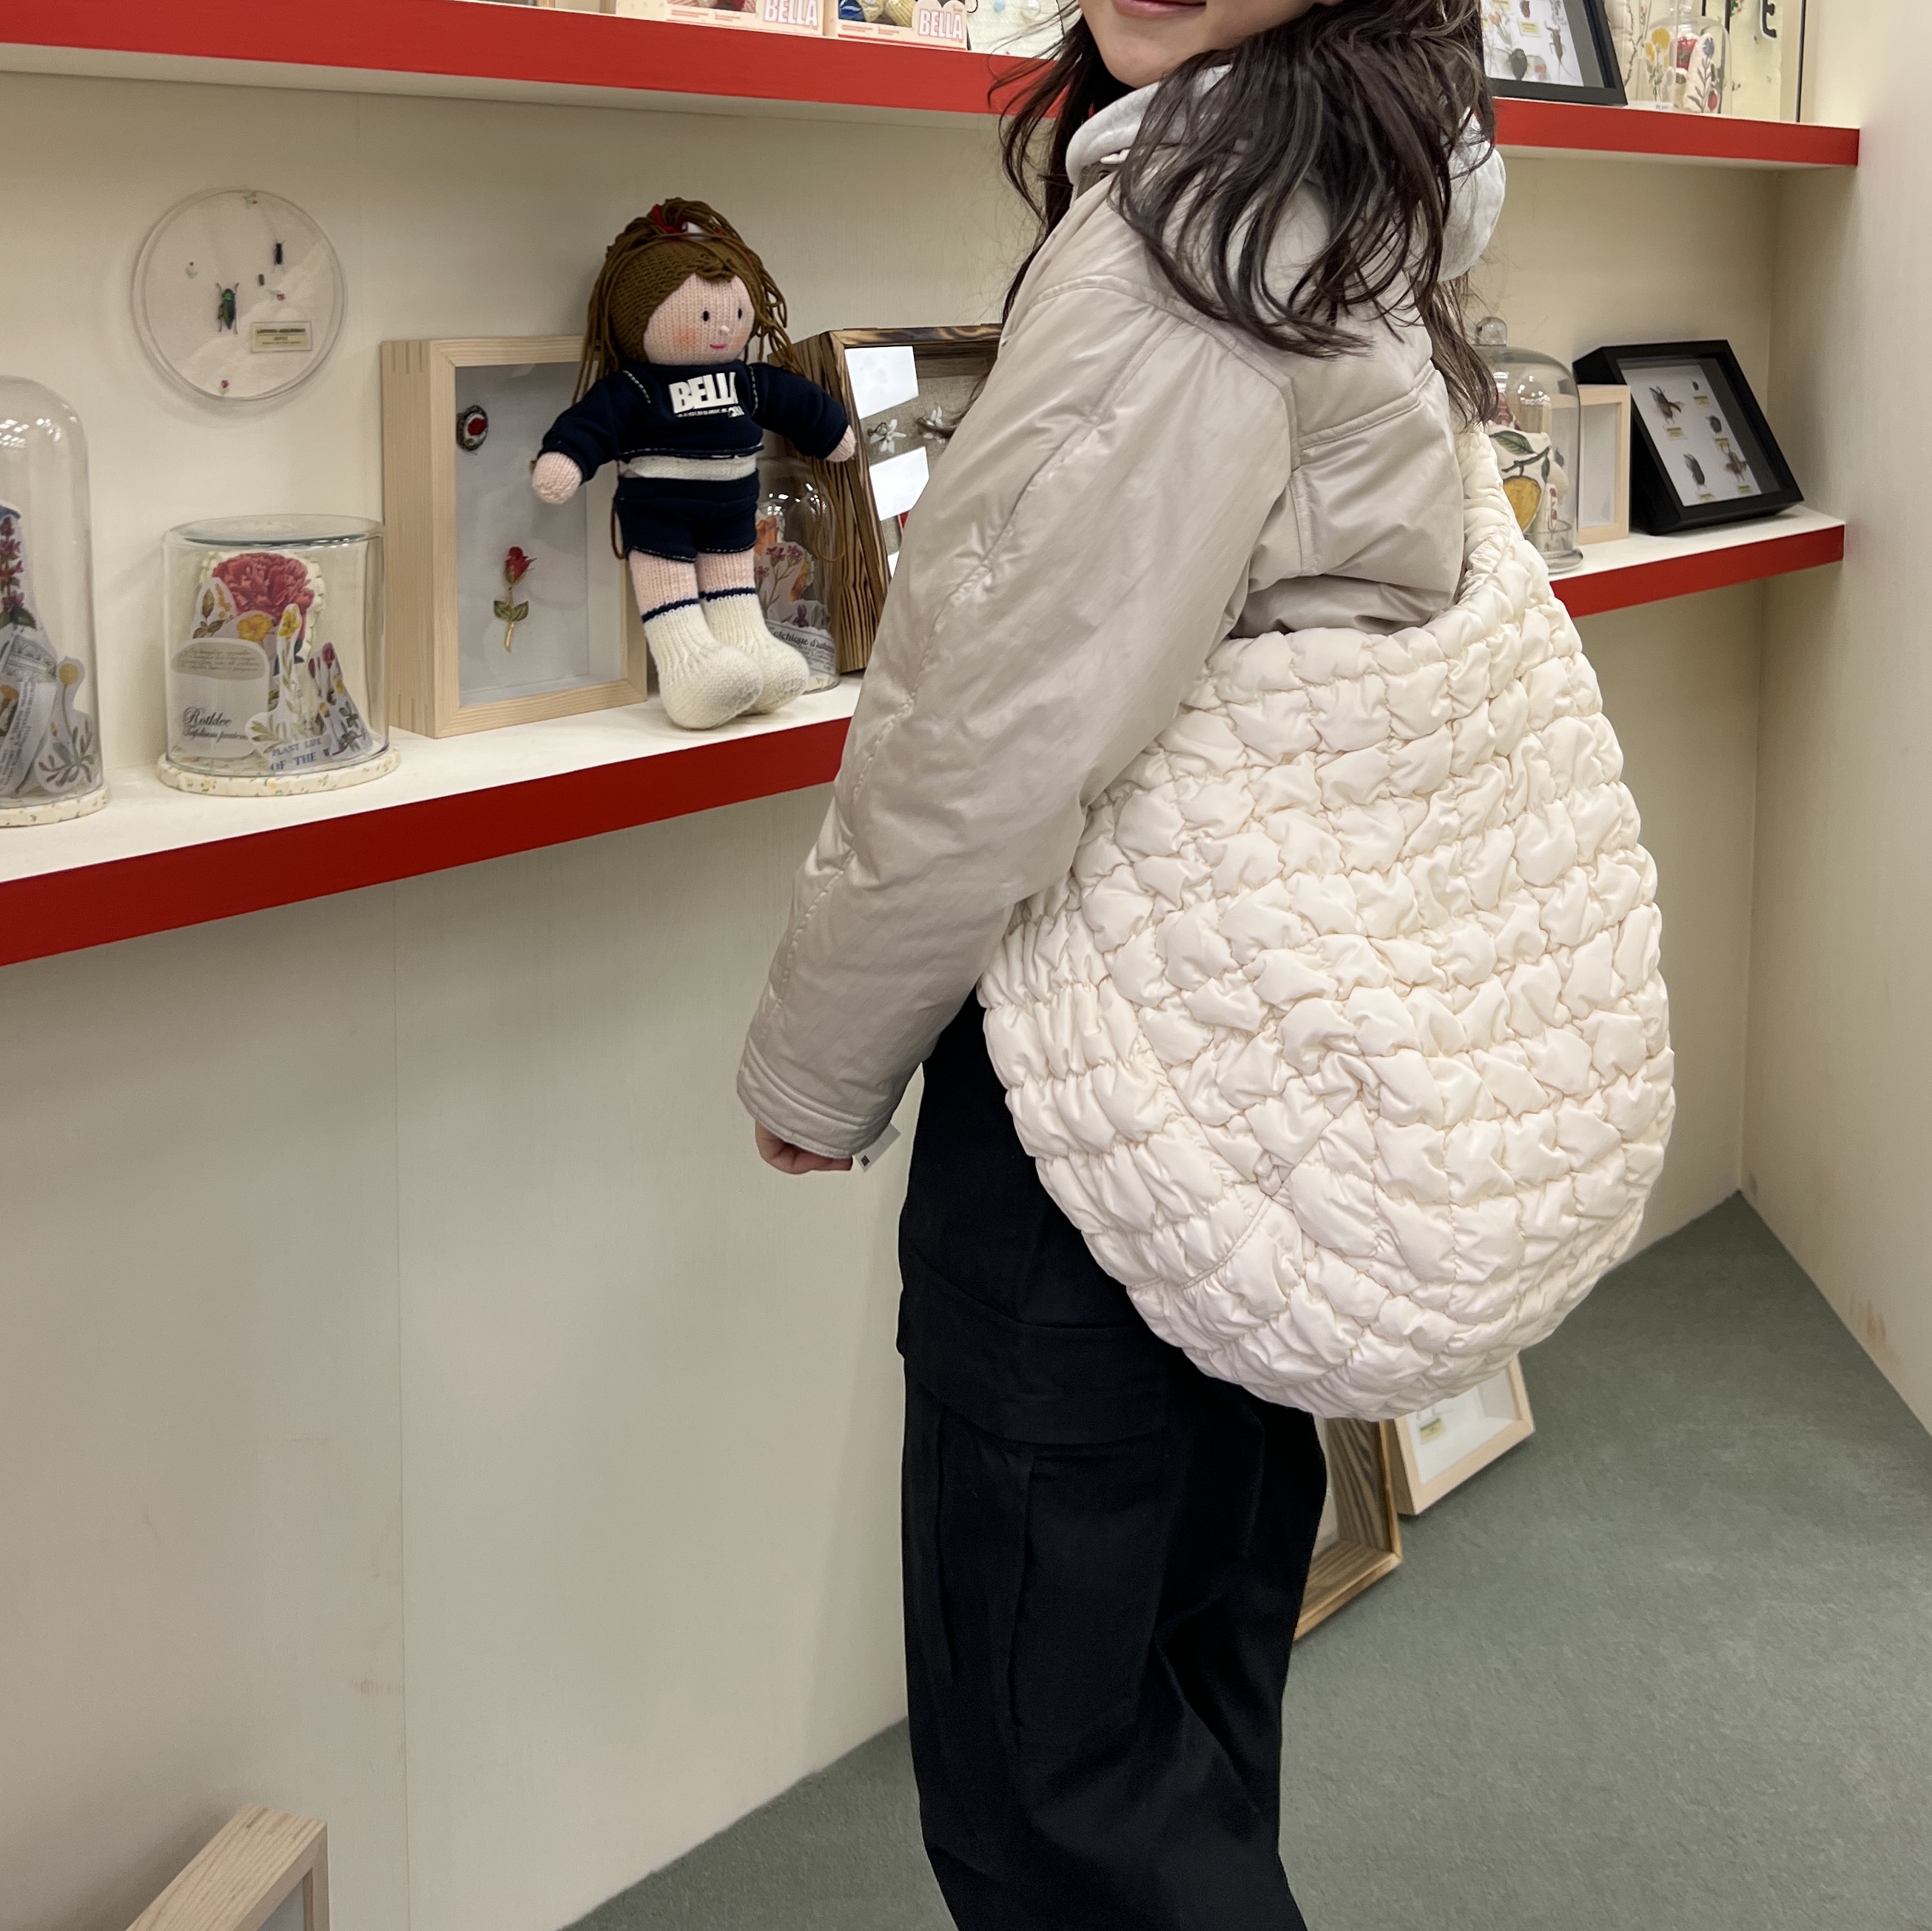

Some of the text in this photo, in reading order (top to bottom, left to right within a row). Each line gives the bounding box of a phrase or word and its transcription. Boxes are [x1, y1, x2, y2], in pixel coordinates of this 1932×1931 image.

[764, 0, 819, 27] BELLA
[918, 8, 963, 40] BELLA
[292, 752, 317, 766] THE
